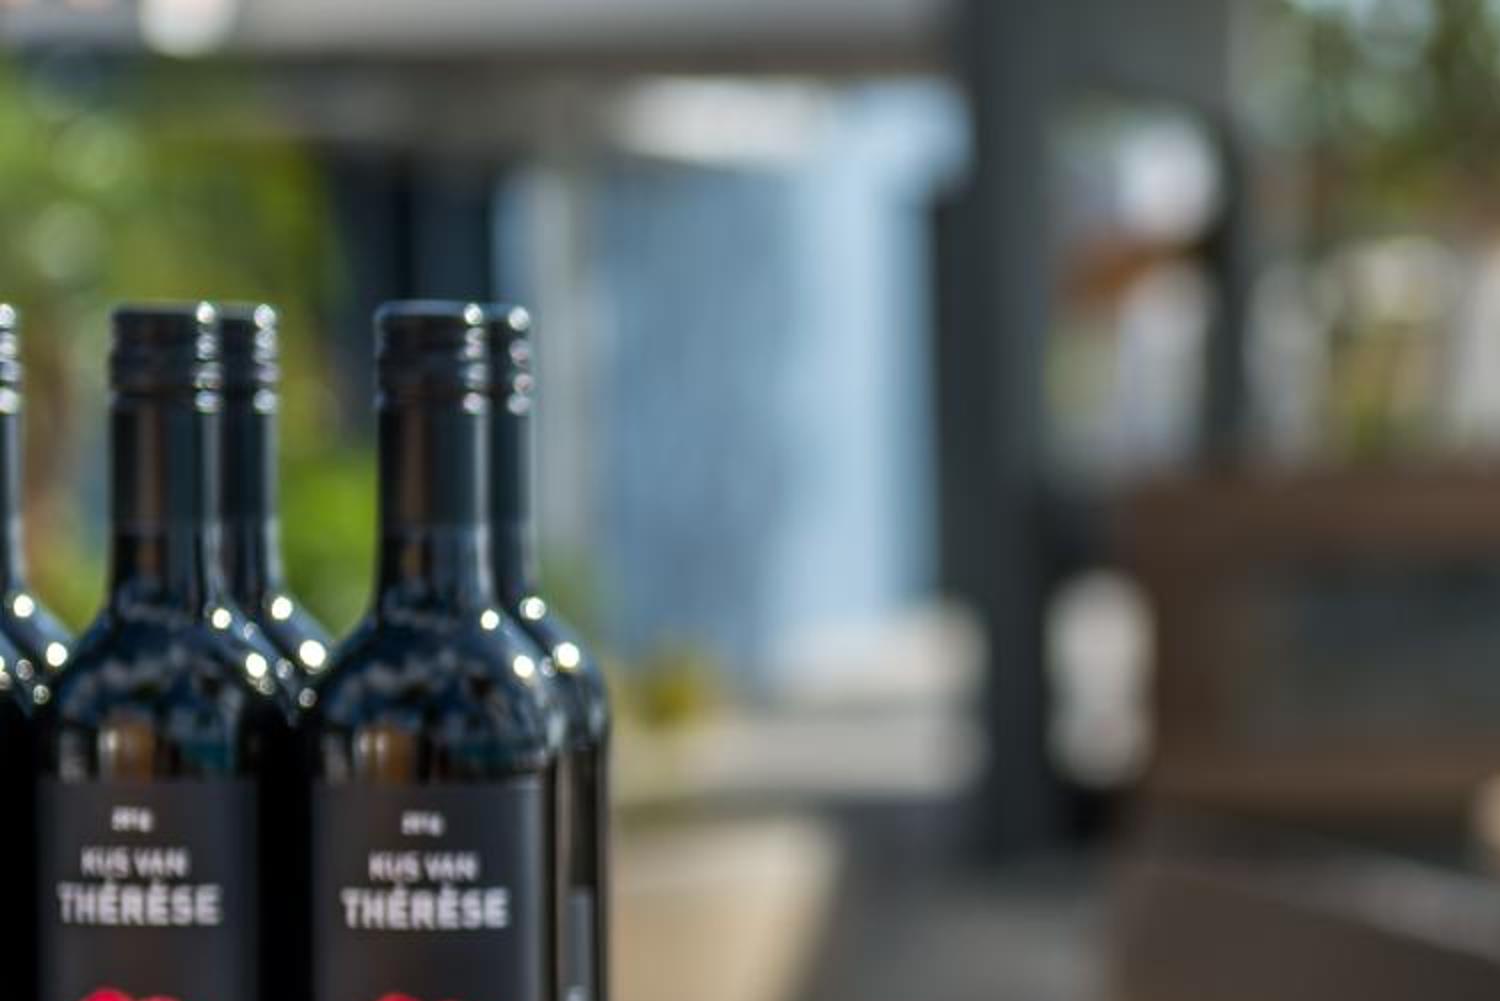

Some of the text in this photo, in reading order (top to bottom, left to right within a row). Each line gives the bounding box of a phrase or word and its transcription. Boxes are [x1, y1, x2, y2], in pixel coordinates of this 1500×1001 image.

[81, 847, 189, 879] KUS VAN
[368, 852, 479, 883] KUS VAN
[58, 880, 219, 926] THÉRÈSE
[341, 884, 509, 930] THÉRÈSE
